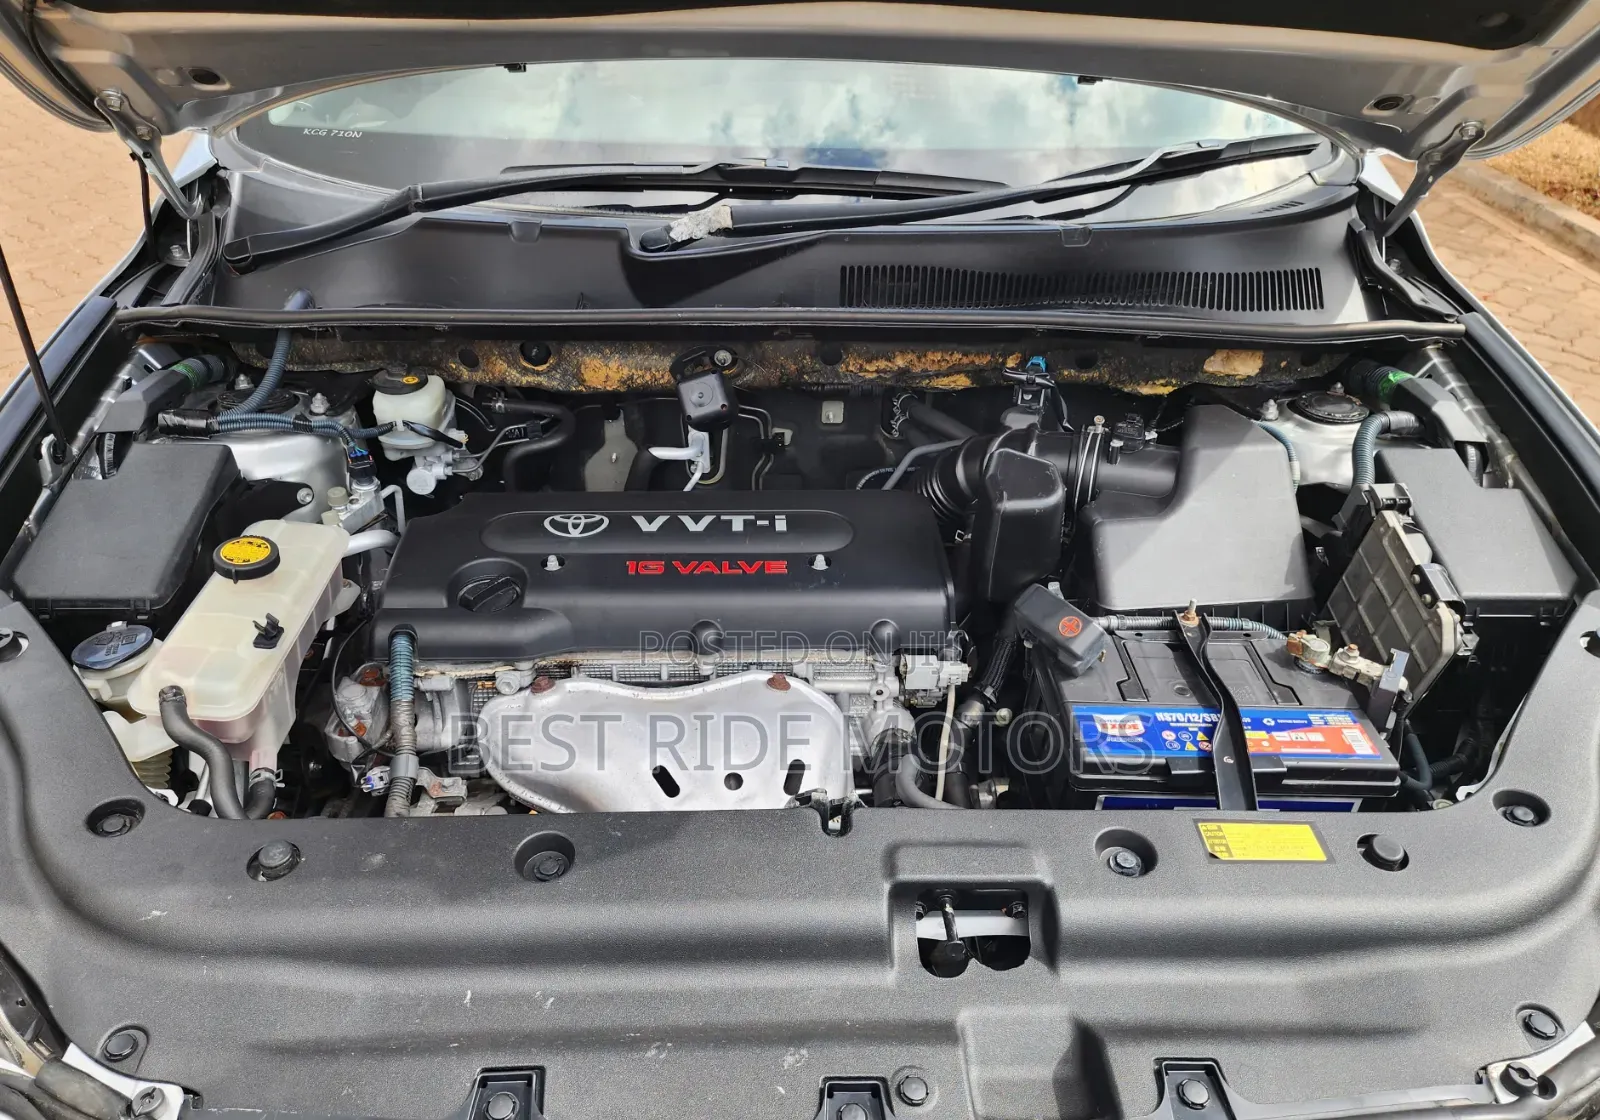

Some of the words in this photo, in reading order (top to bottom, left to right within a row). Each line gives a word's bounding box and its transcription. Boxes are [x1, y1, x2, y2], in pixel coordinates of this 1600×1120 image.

[303, 128, 328, 137] KCG
[330, 130, 363, 138] 710N
[631, 514, 788, 532] VVT-i
[672, 560, 788, 575] VALVE
[1100, 723, 1140, 731] EXIDE
